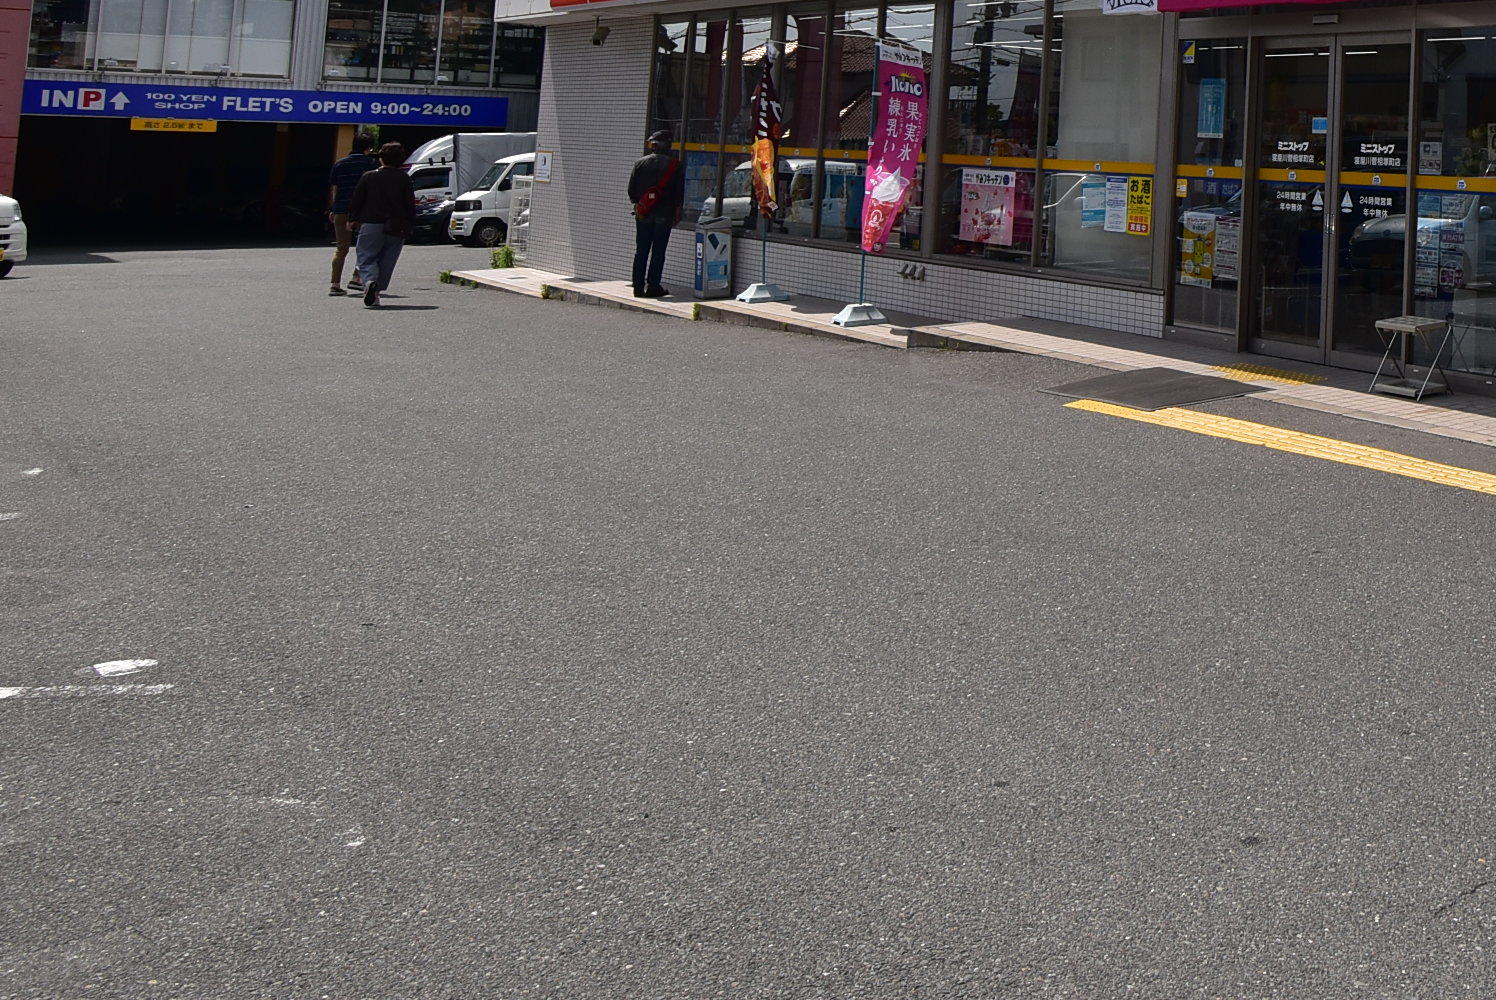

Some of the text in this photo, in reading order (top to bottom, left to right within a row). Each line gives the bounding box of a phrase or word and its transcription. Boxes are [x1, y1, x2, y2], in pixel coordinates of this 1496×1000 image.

[41, 88, 75, 108] IN
[144, 92, 217, 103] 100 YEN
[154, 101, 207, 111] SHOP
[222, 96, 294, 113] FLET'S
[308, 101, 363, 116] OPEN
[897, 100, 919, 162] 果実氷
[1277, 140, 1310, 152] ミニストップ
[1360, 143, 1395, 155] ミニストップ
[1130, 179, 1151, 194] お酒
[1130, 194, 1150, 205] たばこ
[1359, 195, 1393, 207] 24時間営業
